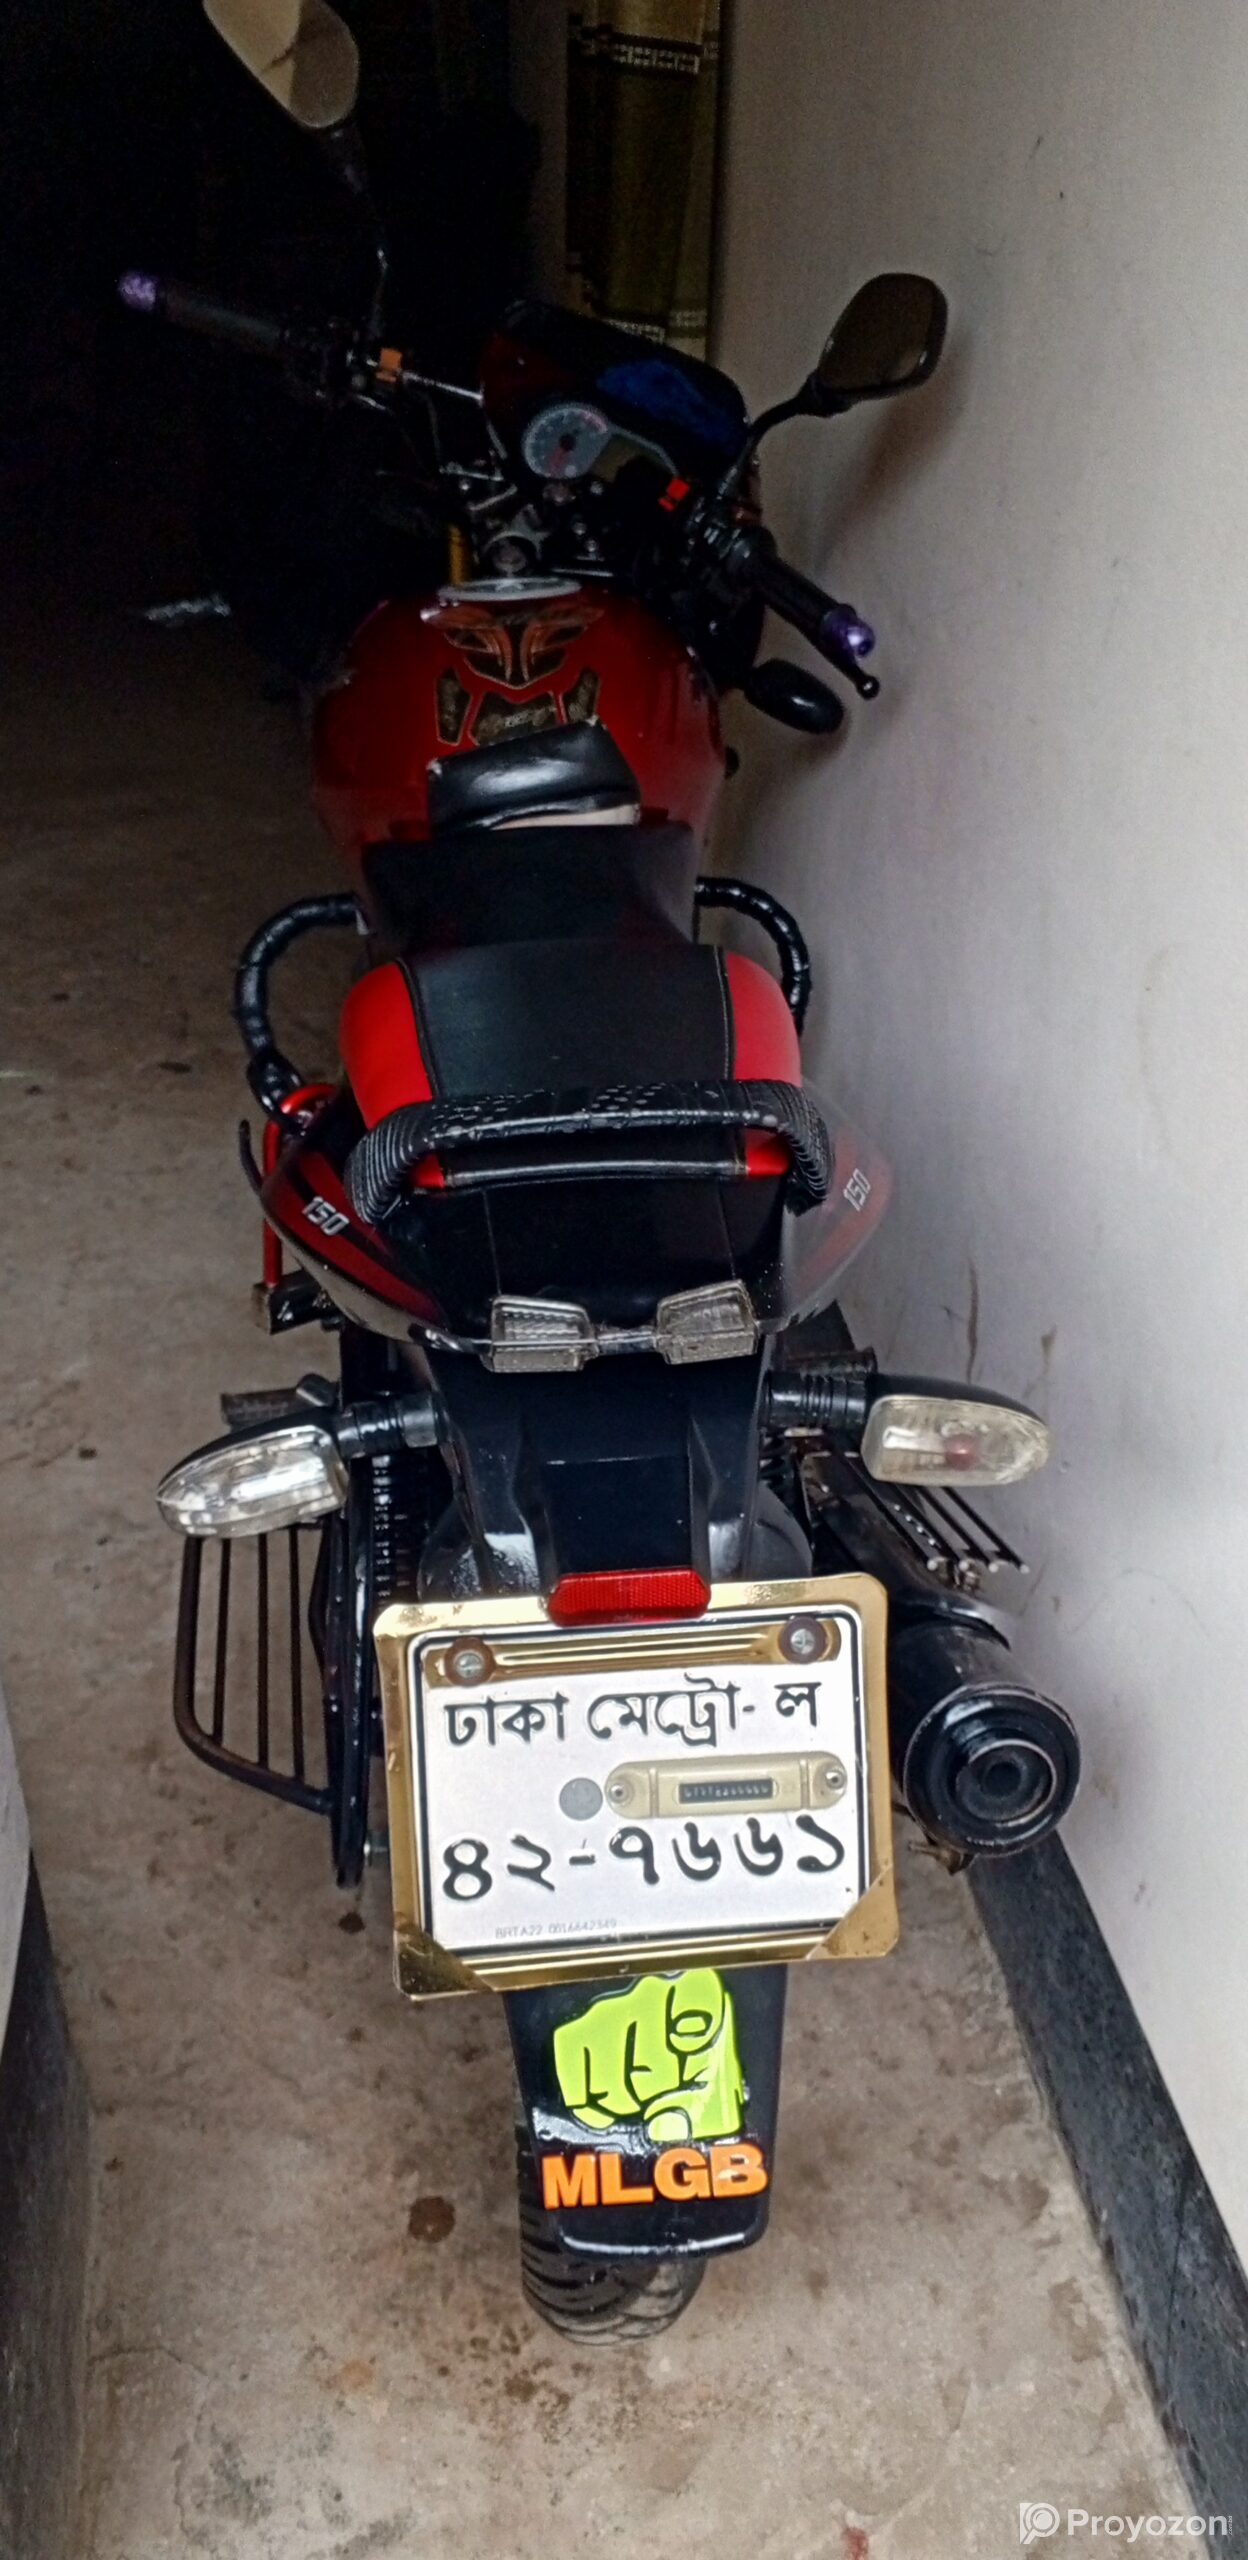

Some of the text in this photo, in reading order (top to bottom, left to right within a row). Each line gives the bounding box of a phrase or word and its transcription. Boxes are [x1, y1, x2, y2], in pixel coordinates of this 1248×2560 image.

[302, 1196, 350, 1235] 150
[843, 1168, 871, 1212] 150
[444, 1691, 569, 1747] ঢাকা
[774, 1681, 822, 1728] ল
[542, 2143, 768, 2210] MLGB
